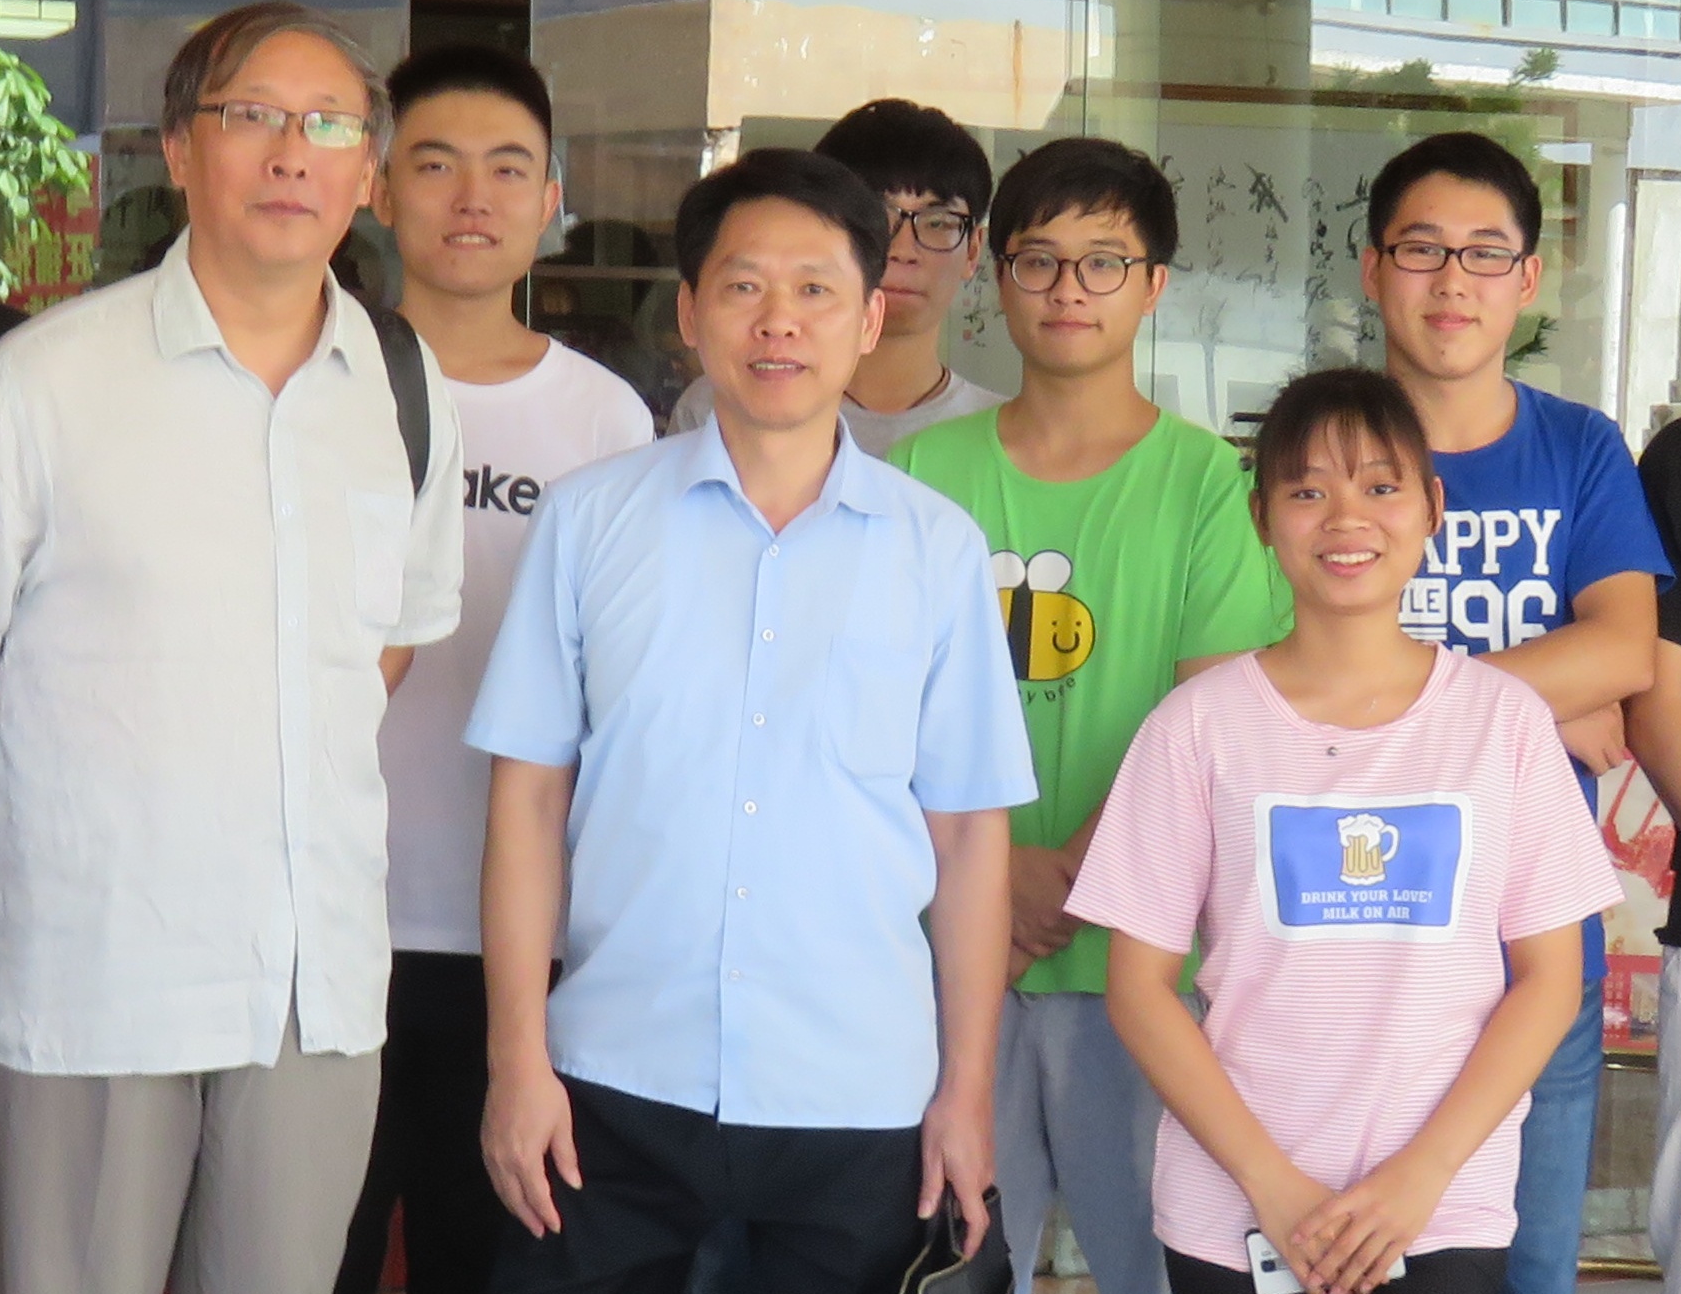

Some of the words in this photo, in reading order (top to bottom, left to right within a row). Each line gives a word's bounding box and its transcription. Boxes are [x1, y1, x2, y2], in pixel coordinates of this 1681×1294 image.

[462, 463, 547, 515] ake
[1402, 588, 1441, 613] LE
[1301, 890, 1347, 904] DRINK
[1350, 889, 1389, 904] YOUR
[1322, 906, 1360, 920] MILK
[1363, 906, 1384, 920] ON
[1387, 906, 1411, 920] AIR
